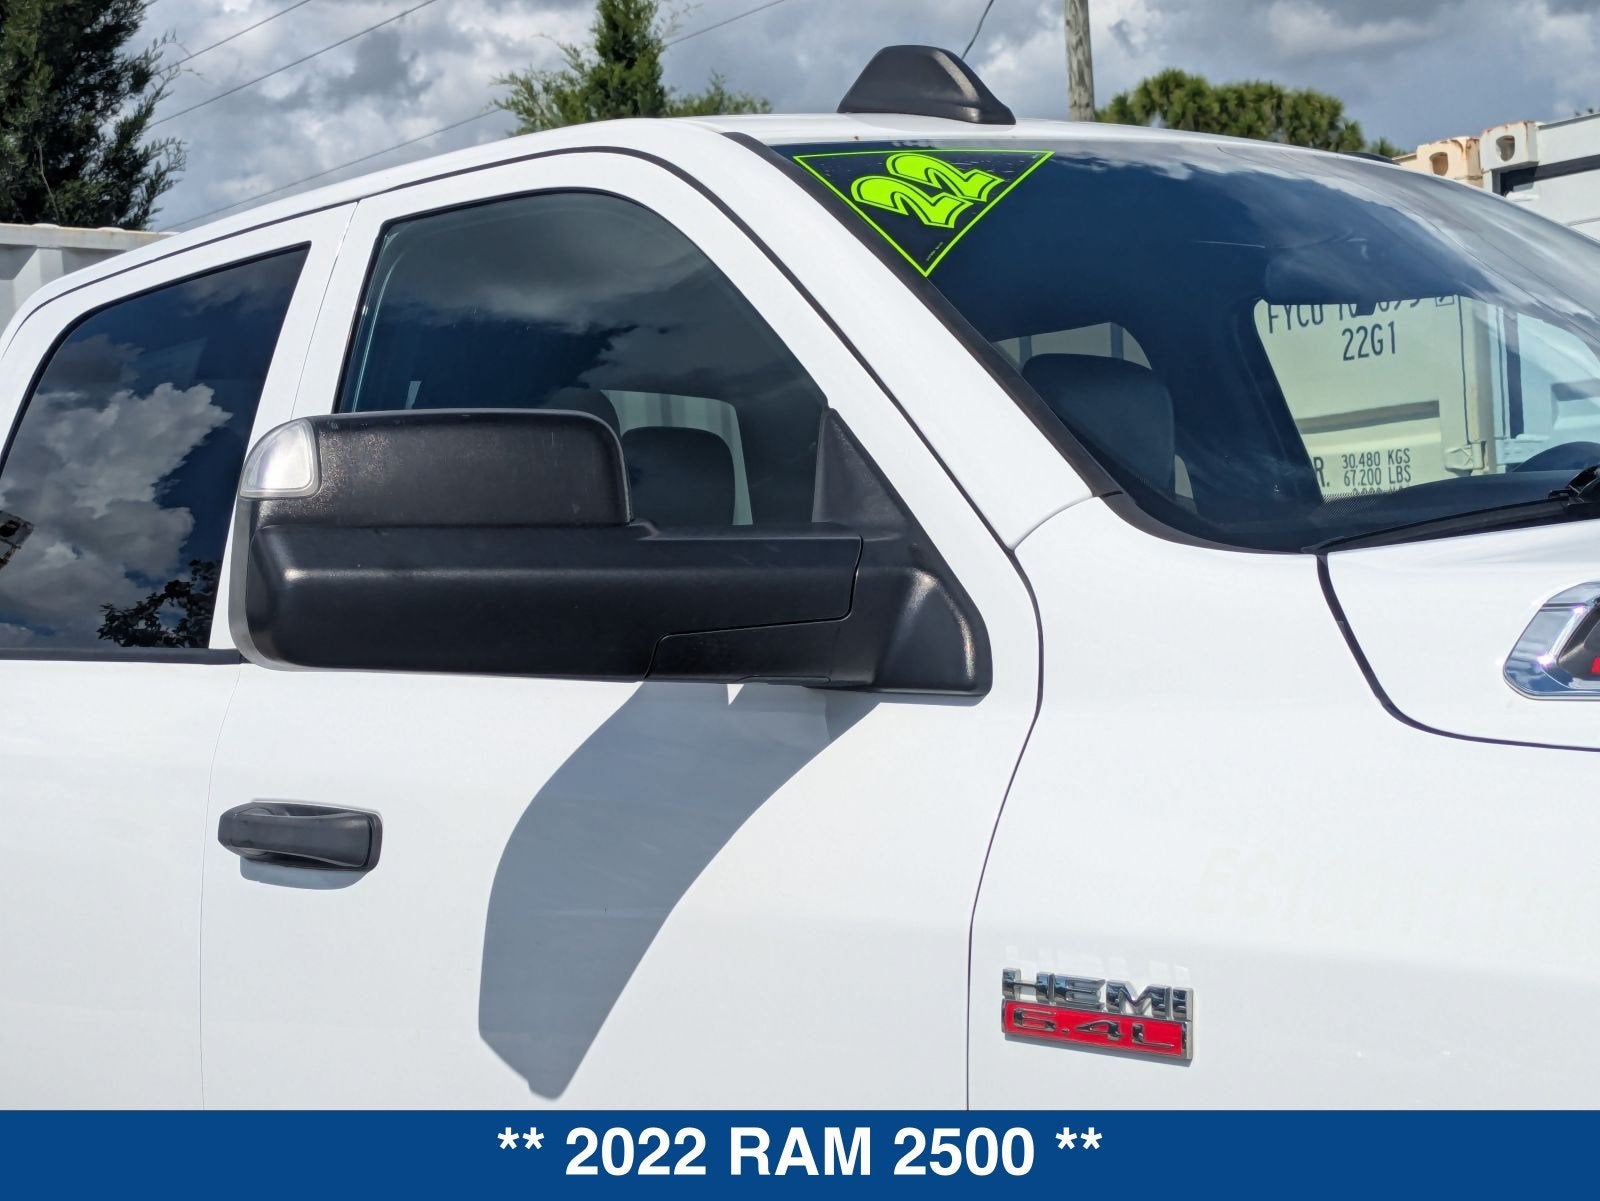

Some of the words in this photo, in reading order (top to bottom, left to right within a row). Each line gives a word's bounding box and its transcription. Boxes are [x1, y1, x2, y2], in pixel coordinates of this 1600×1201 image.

[851, 153, 1005, 228] 22
[1341, 321, 1396, 361] 22G1
[1387, 448, 1411, 465] KGS
[1388, 464, 1412, 484] LBS
[1002, 967, 1193, 1022] HEMI
[1013, 1007, 1176, 1049] 6.4L
